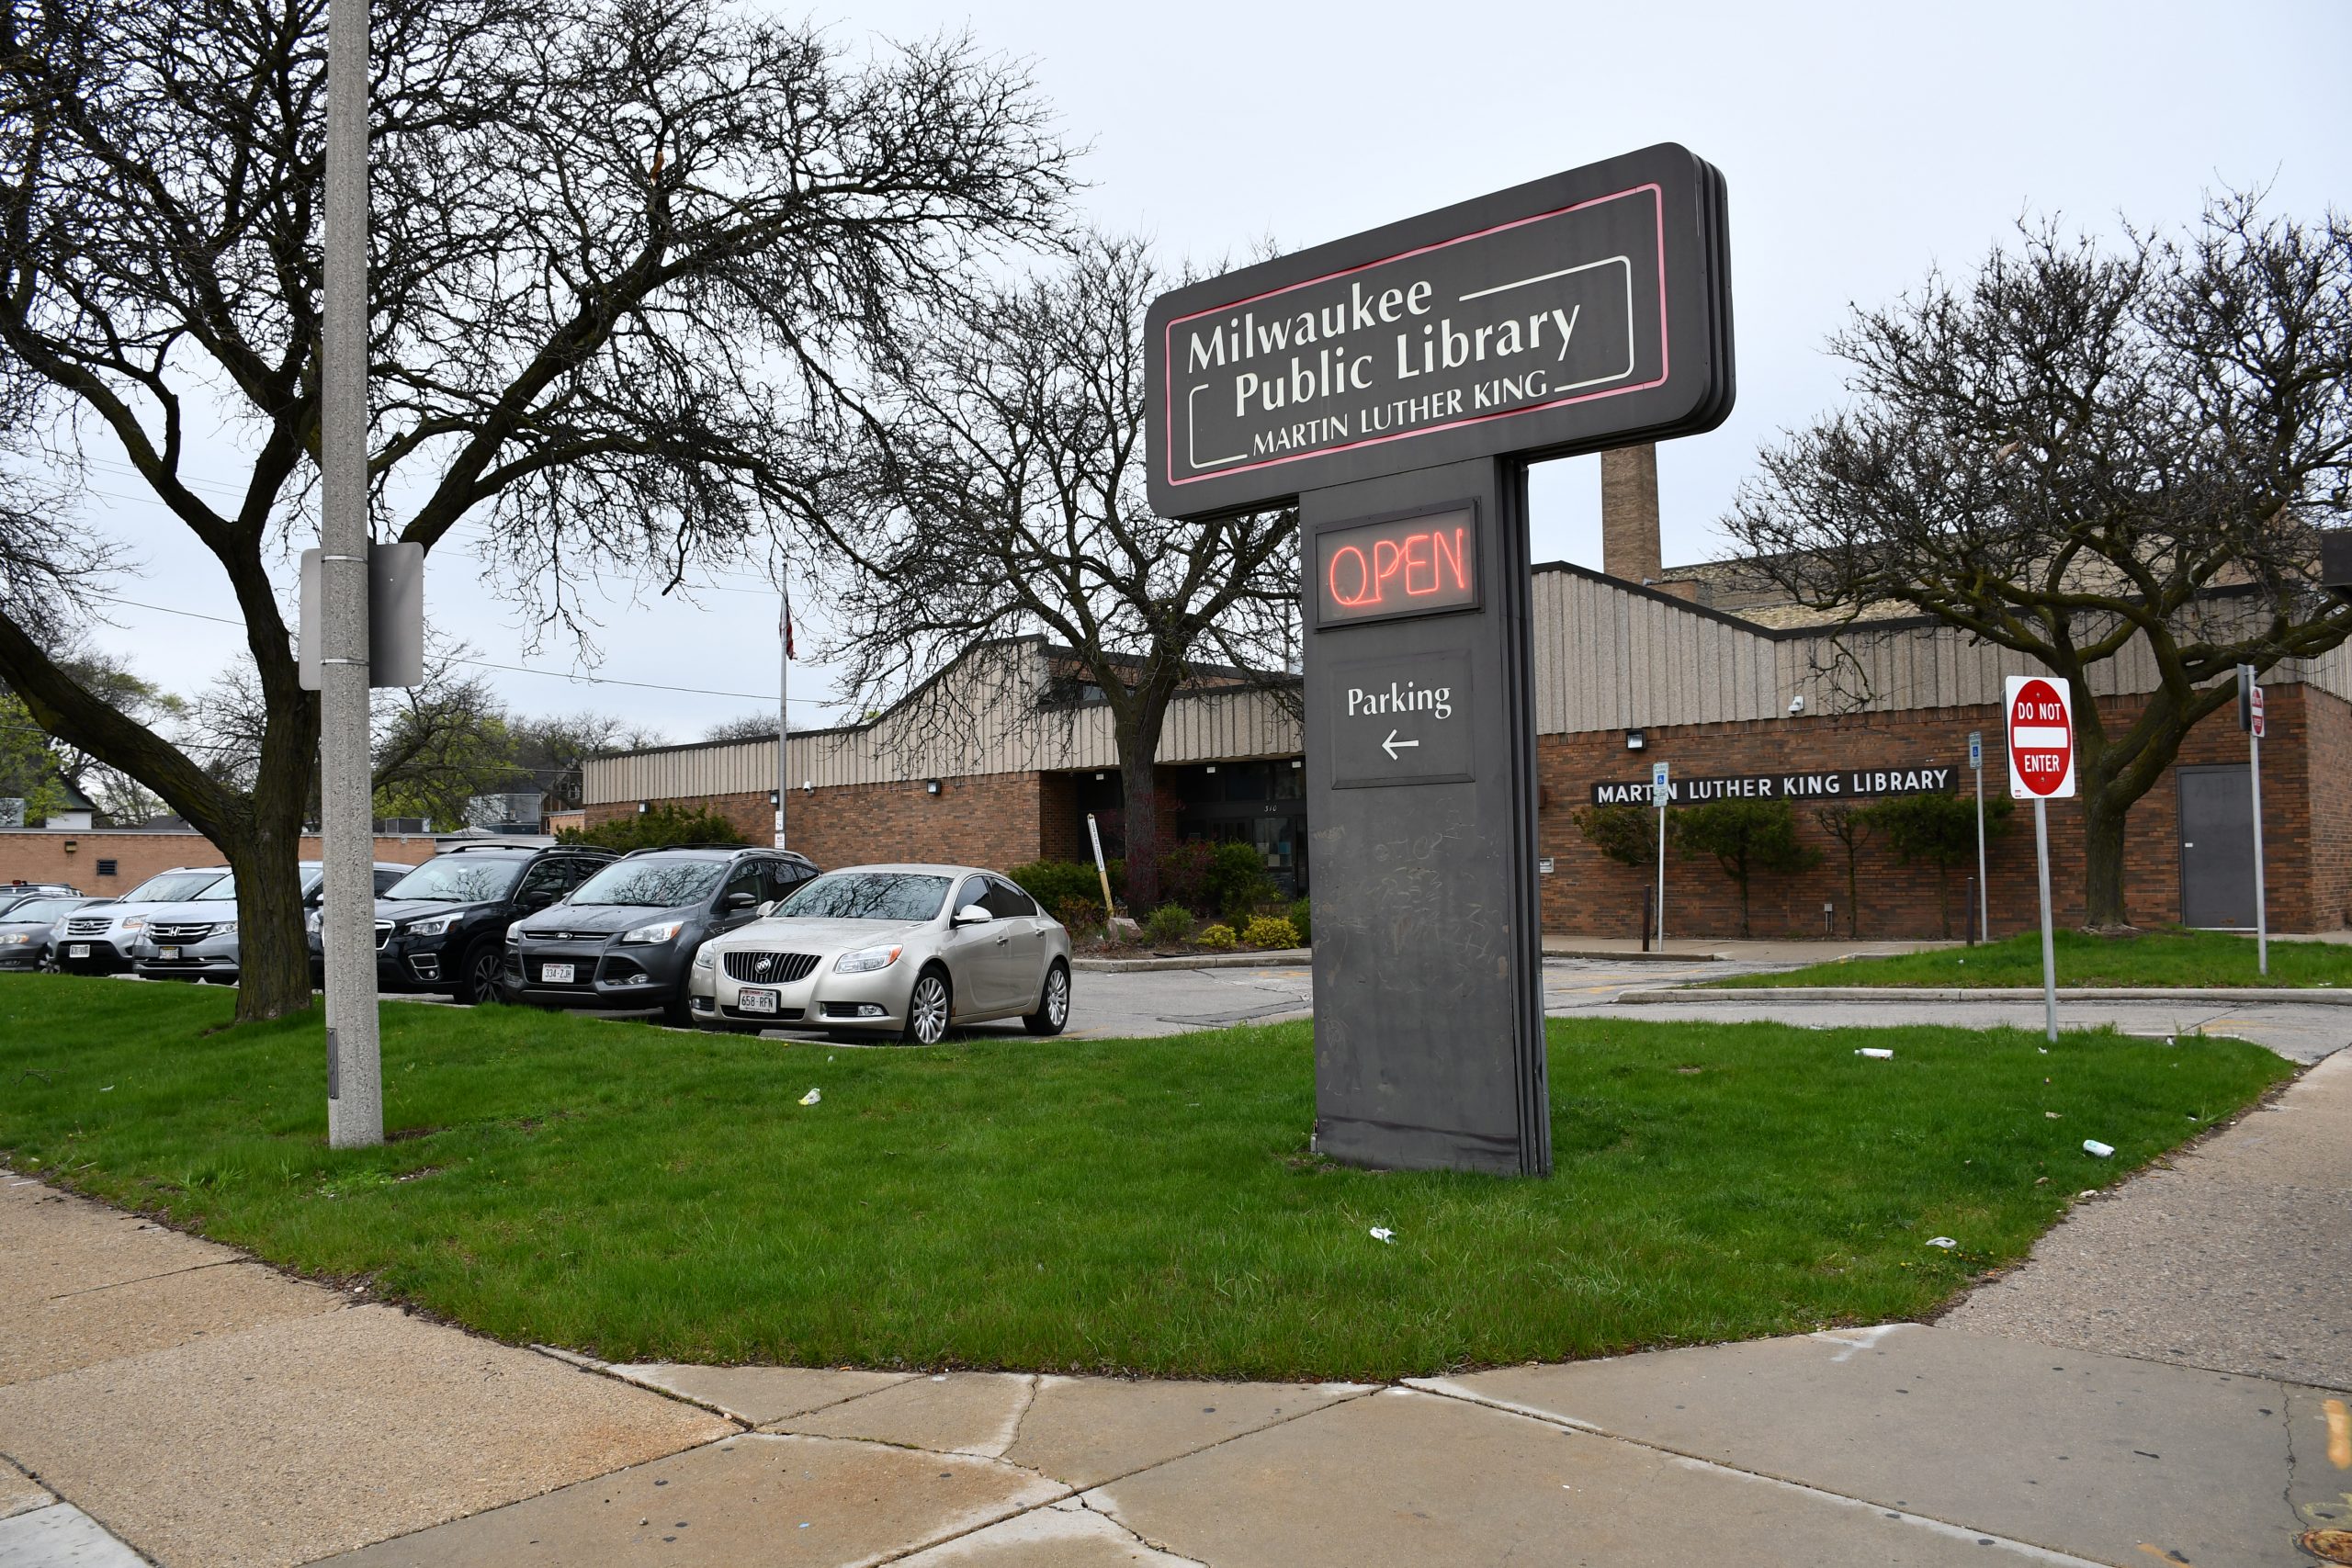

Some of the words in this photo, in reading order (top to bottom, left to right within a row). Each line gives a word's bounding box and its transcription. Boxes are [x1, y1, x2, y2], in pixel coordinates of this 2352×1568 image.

[1188, 280, 1432, 373] Milwaukee
[1236, 346, 1373, 418] Public
[1396, 304, 1580, 379] Library
[1253, 413, 1348, 457] MARTIN
[1361, 389, 1464, 434] LUTHER
[1474, 369, 1547, 410] KING
[1329, 528, 1465, 607] OPEN
[1348, 681, 1453, 719] Parking
[2018, 702, 2034, 720] DO
[2039, 702, 2061, 721] NOT
[2024, 753, 2060, 773] ENTER
[1598, 783, 1678, 804] MARTN
[1689, 778, 1772, 799] LUTHER
[1783, 774, 1840, 795] KING
[1853, 769, 1949, 793] LIBRARY
[741, 995, 774, 1008] 658-RFN
